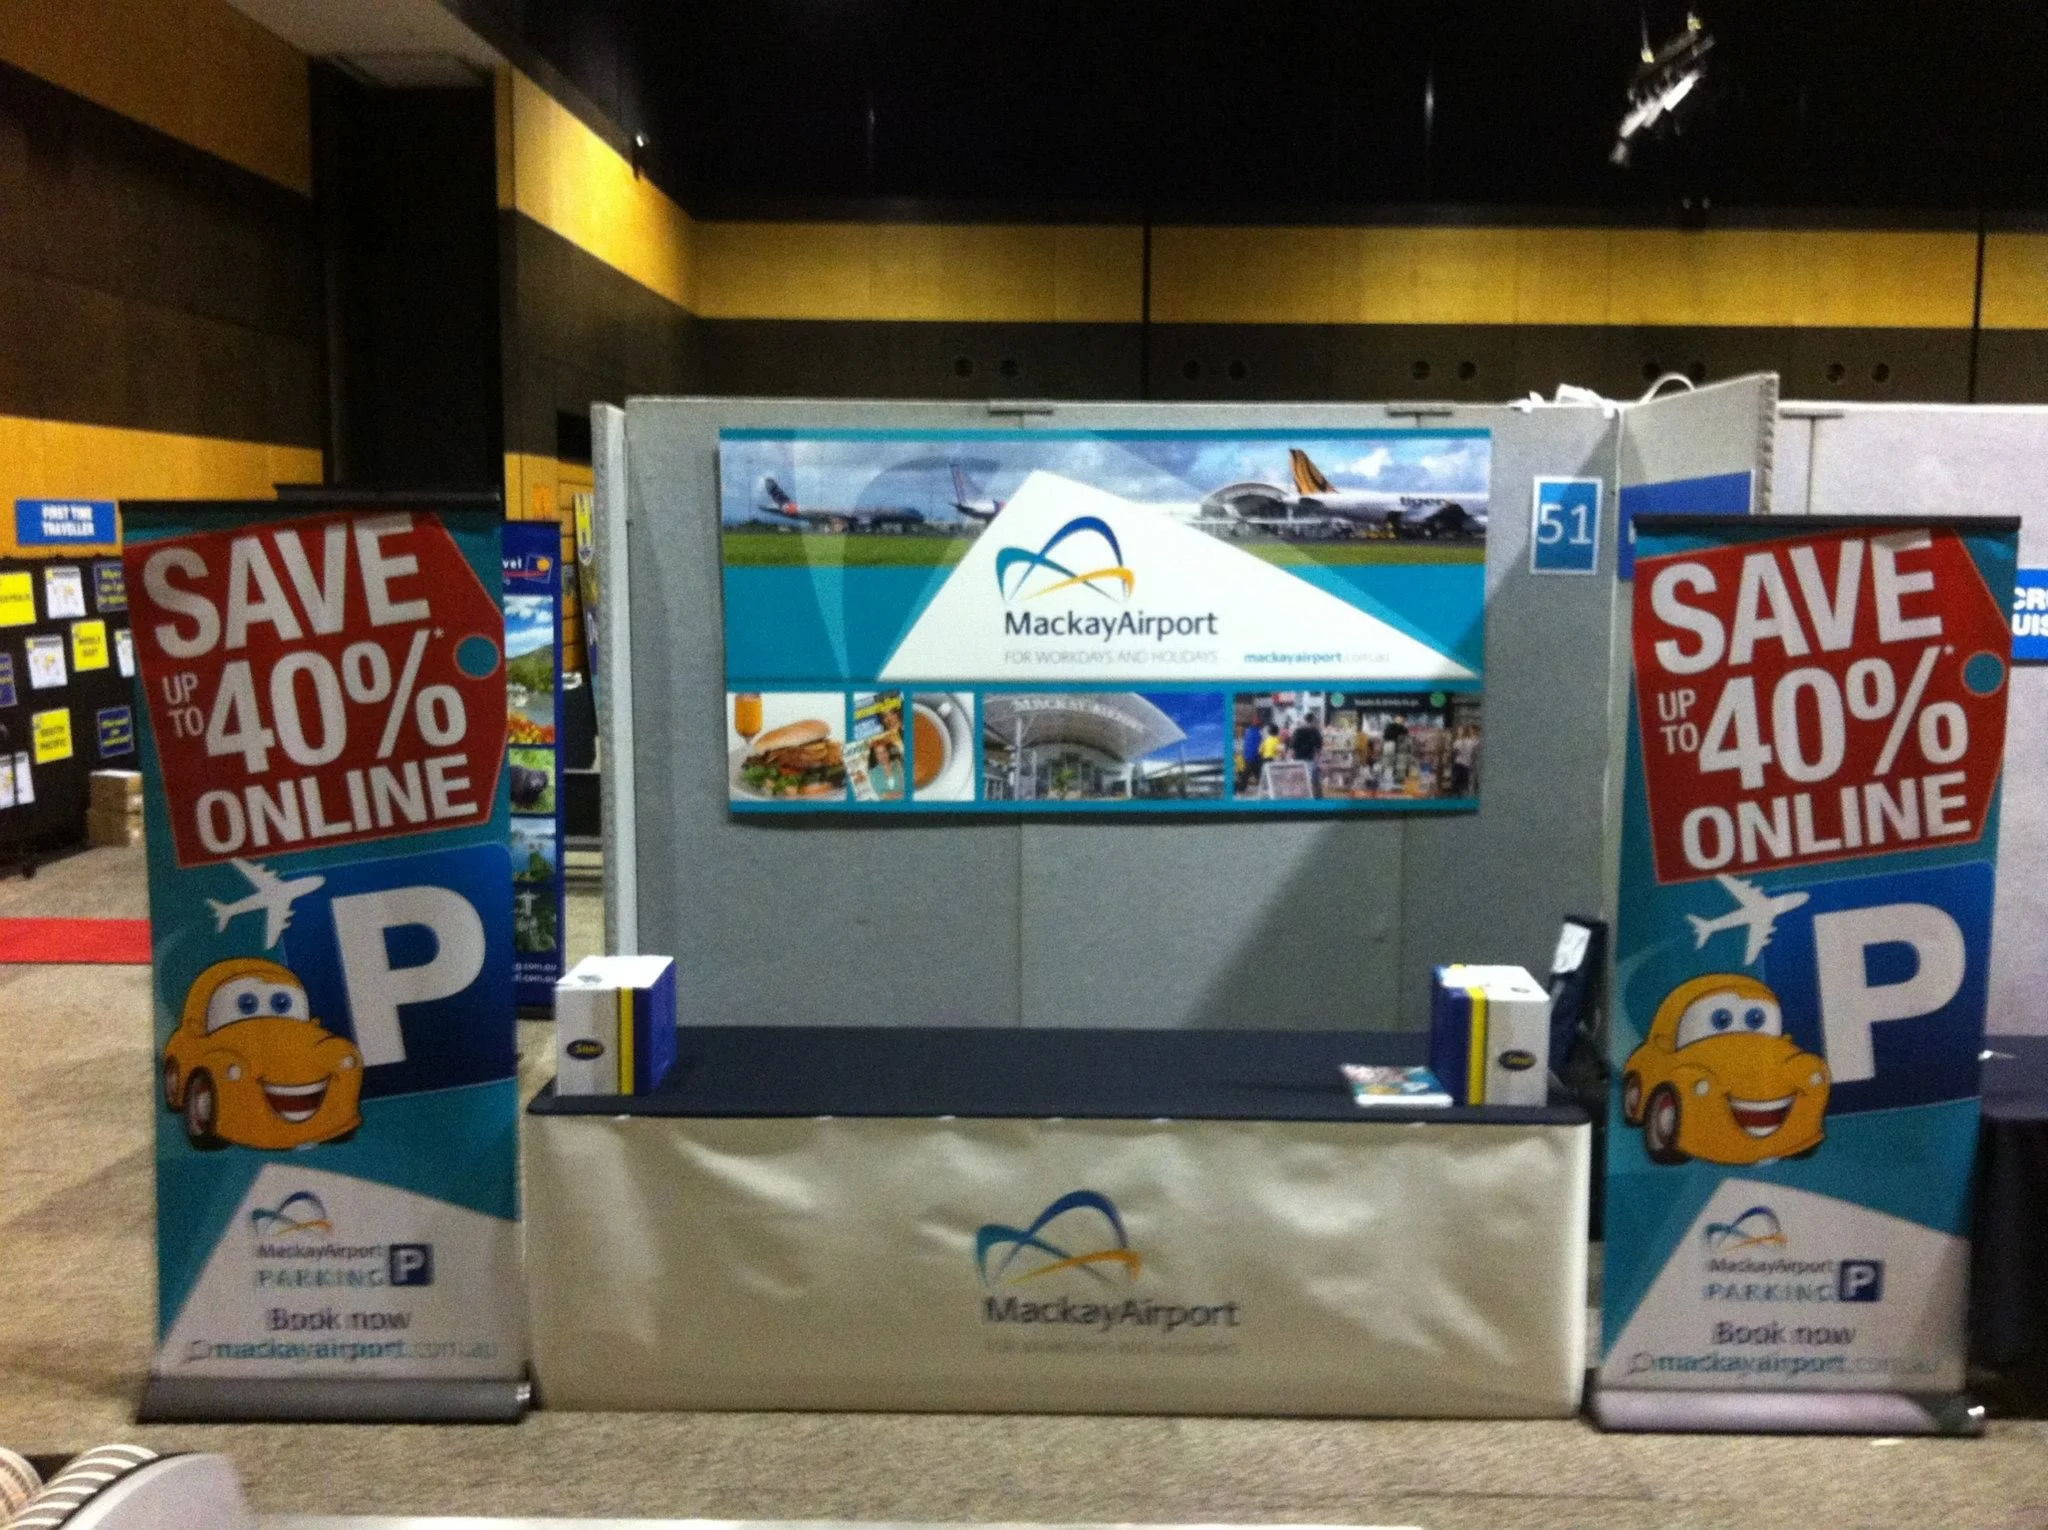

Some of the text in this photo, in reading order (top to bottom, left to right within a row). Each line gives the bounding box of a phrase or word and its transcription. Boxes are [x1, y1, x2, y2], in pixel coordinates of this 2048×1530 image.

[42, 521, 95, 536] TRAVELLER
[1538, 503, 1593, 546] 51
[142, 512, 431, 660] SAVE
[1650, 529, 1943, 675] SAVE
[1004, 610, 1219, 642] MackayAirport
[1004, 651, 1218, 664] FOR WORKDAYS AND HOLIDAYS
[1243, 651, 1390, 664] mackayairport.com.au
[161, 671, 199, 705] UP
[1658, 689, 1697, 722] UP
[167, 708, 202, 738] TO
[1661, 724, 1699, 754] TO
[195, 753, 478, 854] ONLINE
[1681, 771, 1972, 870] ONLINE
[331, 885, 486, 1068] P
[1813, 902, 1967, 1083] P
[256, 1243, 383, 1262] MackayAirport
[395, 1249, 426, 1283] P
[1707, 1258, 1836, 1276] MackayAirport
[256, 1269, 384, 1288] PARKING
[1705, 1282, 1836, 1301] PARKING
[1845, 1264, 1877, 1297] P
[268, 1308, 412, 1331] Book now
[983, 1296, 1240, 1332] MackayAirport
[1714, 1321, 1858, 1345] Book now
[213, 1340, 499, 1362] mackayairport.com.au
[1653, 1354, 1938, 1377] mackayairport.com.au
